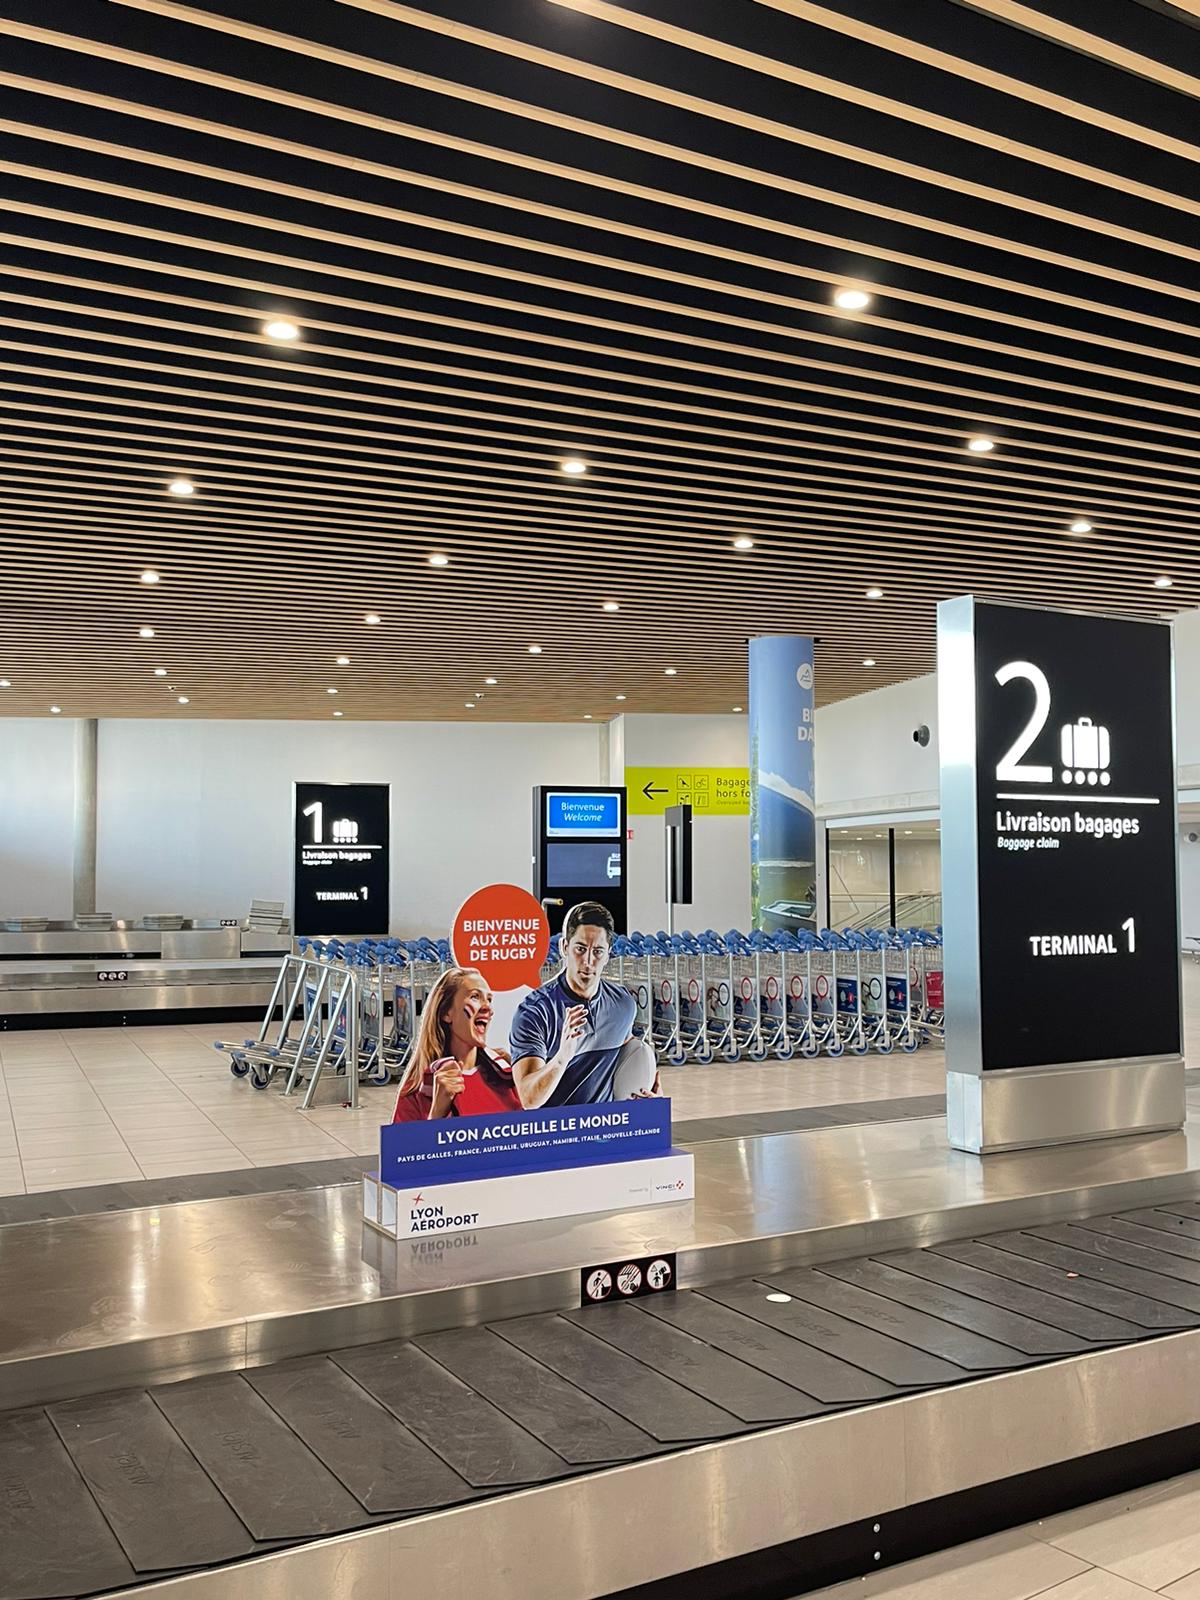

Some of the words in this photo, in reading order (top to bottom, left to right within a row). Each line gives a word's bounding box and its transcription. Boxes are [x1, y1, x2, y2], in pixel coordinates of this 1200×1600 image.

[994, 660, 1053, 783] 2
[716, 789, 738, 798] hors
[561, 802, 605, 811] Bienvenue
[302, 801, 323, 843] 1
[564, 813, 602, 822] Welcome
[996, 811, 1072, 835] Livraison
[1074, 811, 1140, 838] bagages
[996, 837, 1034, 850] Baggage
[1036, 837, 1060, 849] claim
[302, 851, 338, 860] Livraison
[339, 851, 371, 862] bagages
[316, 892, 359, 901] TERMINAL
[360, 886, 369, 901] 1
[463, 918, 540, 933] BIENVENUE
[470, 934, 499, 947] AUX
[502, 932, 537, 945] FANS
[1029, 933, 1117, 957] TERMINAL
[1122, 917, 1136, 953] 1
[470, 948, 488, 962] DE
[491, 946, 537, 961] RUGBY
[437, 1128, 479, 1145] LYON
[482, 1121, 557, 1140] ACCUEILLE
[560, 1119, 577, 1131] LE
[579, 1112, 630, 1129] MONDE
[397, 1155, 415, 1163] PAYS
[411, 1206, 443, 1220] LYON
[411, 1213, 479, 1232] AÉROPORT
